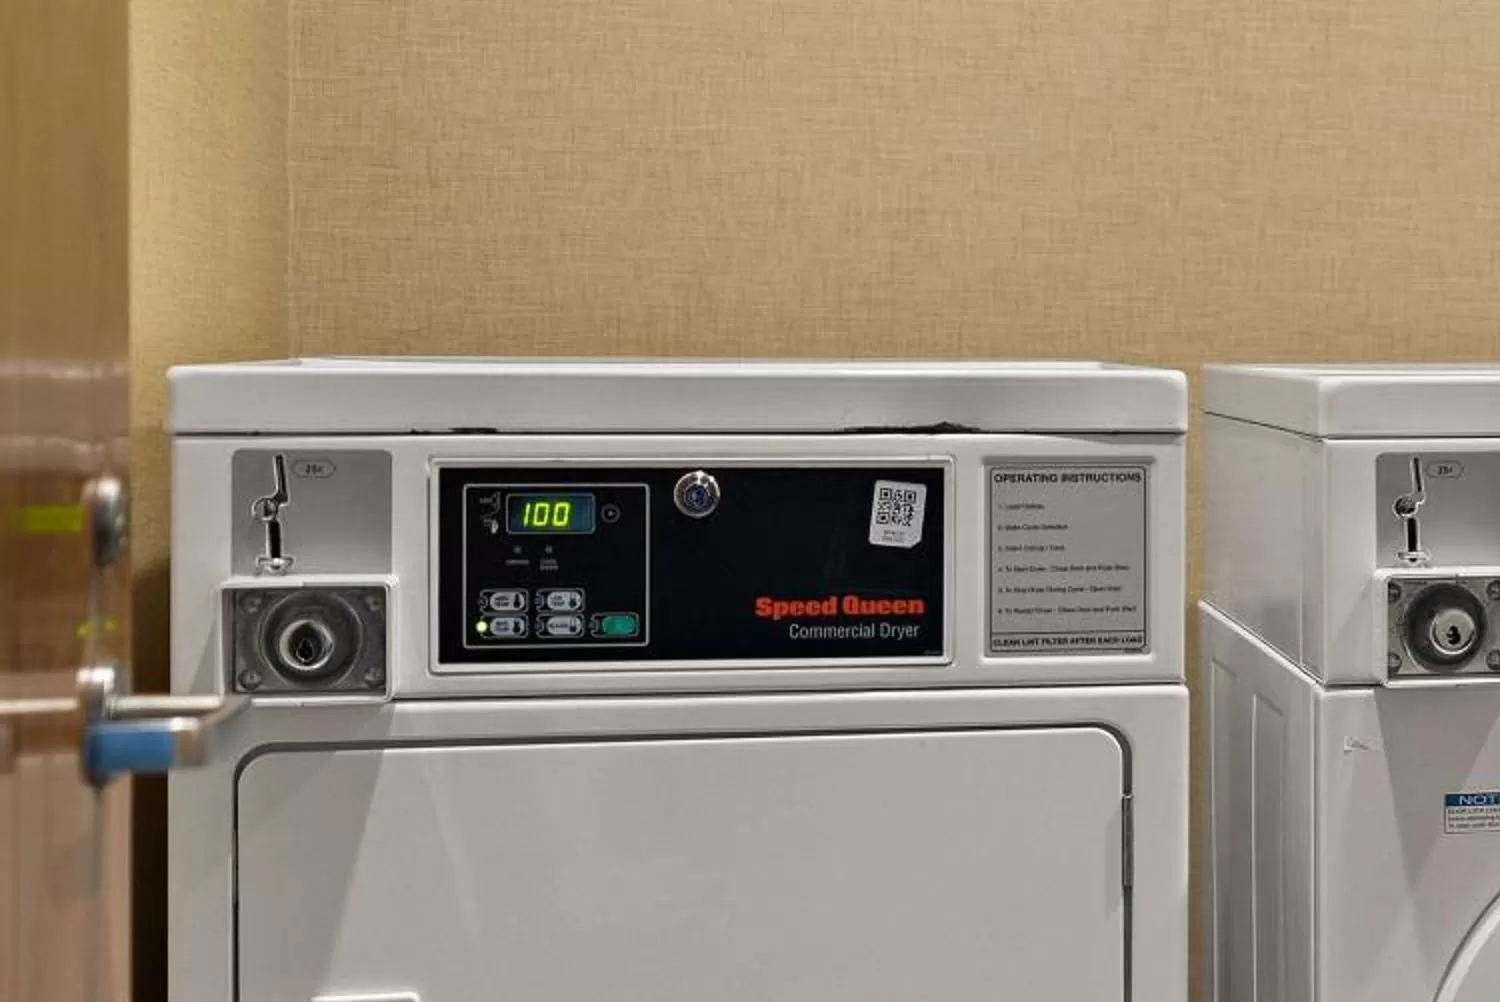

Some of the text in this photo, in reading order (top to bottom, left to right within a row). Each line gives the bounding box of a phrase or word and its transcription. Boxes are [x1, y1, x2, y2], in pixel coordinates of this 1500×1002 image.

[993, 472, 1142, 484] OPERATING INSTRUCTIONS
[523, 502, 571, 527] 100
[755, 595, 925, 621] Speed Queen
[789, 622, 921, 641] Commercial Dryer
